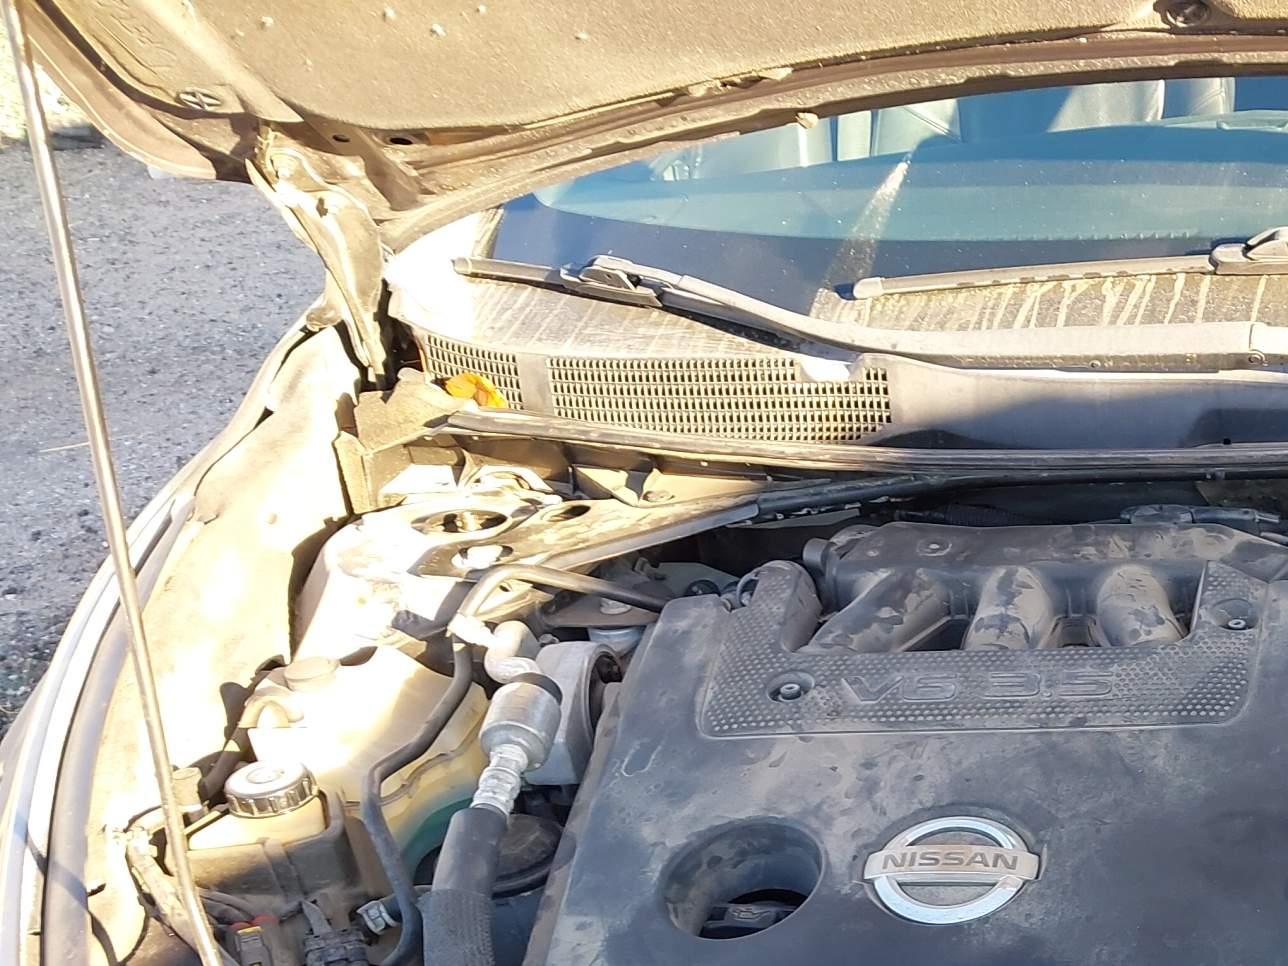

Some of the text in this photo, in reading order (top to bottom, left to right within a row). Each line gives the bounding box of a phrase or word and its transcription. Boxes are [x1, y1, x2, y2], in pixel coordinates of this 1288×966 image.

[841, 671, 1114, 704] V6 3.5
[882, 851, 1018, 871] NISSAN
